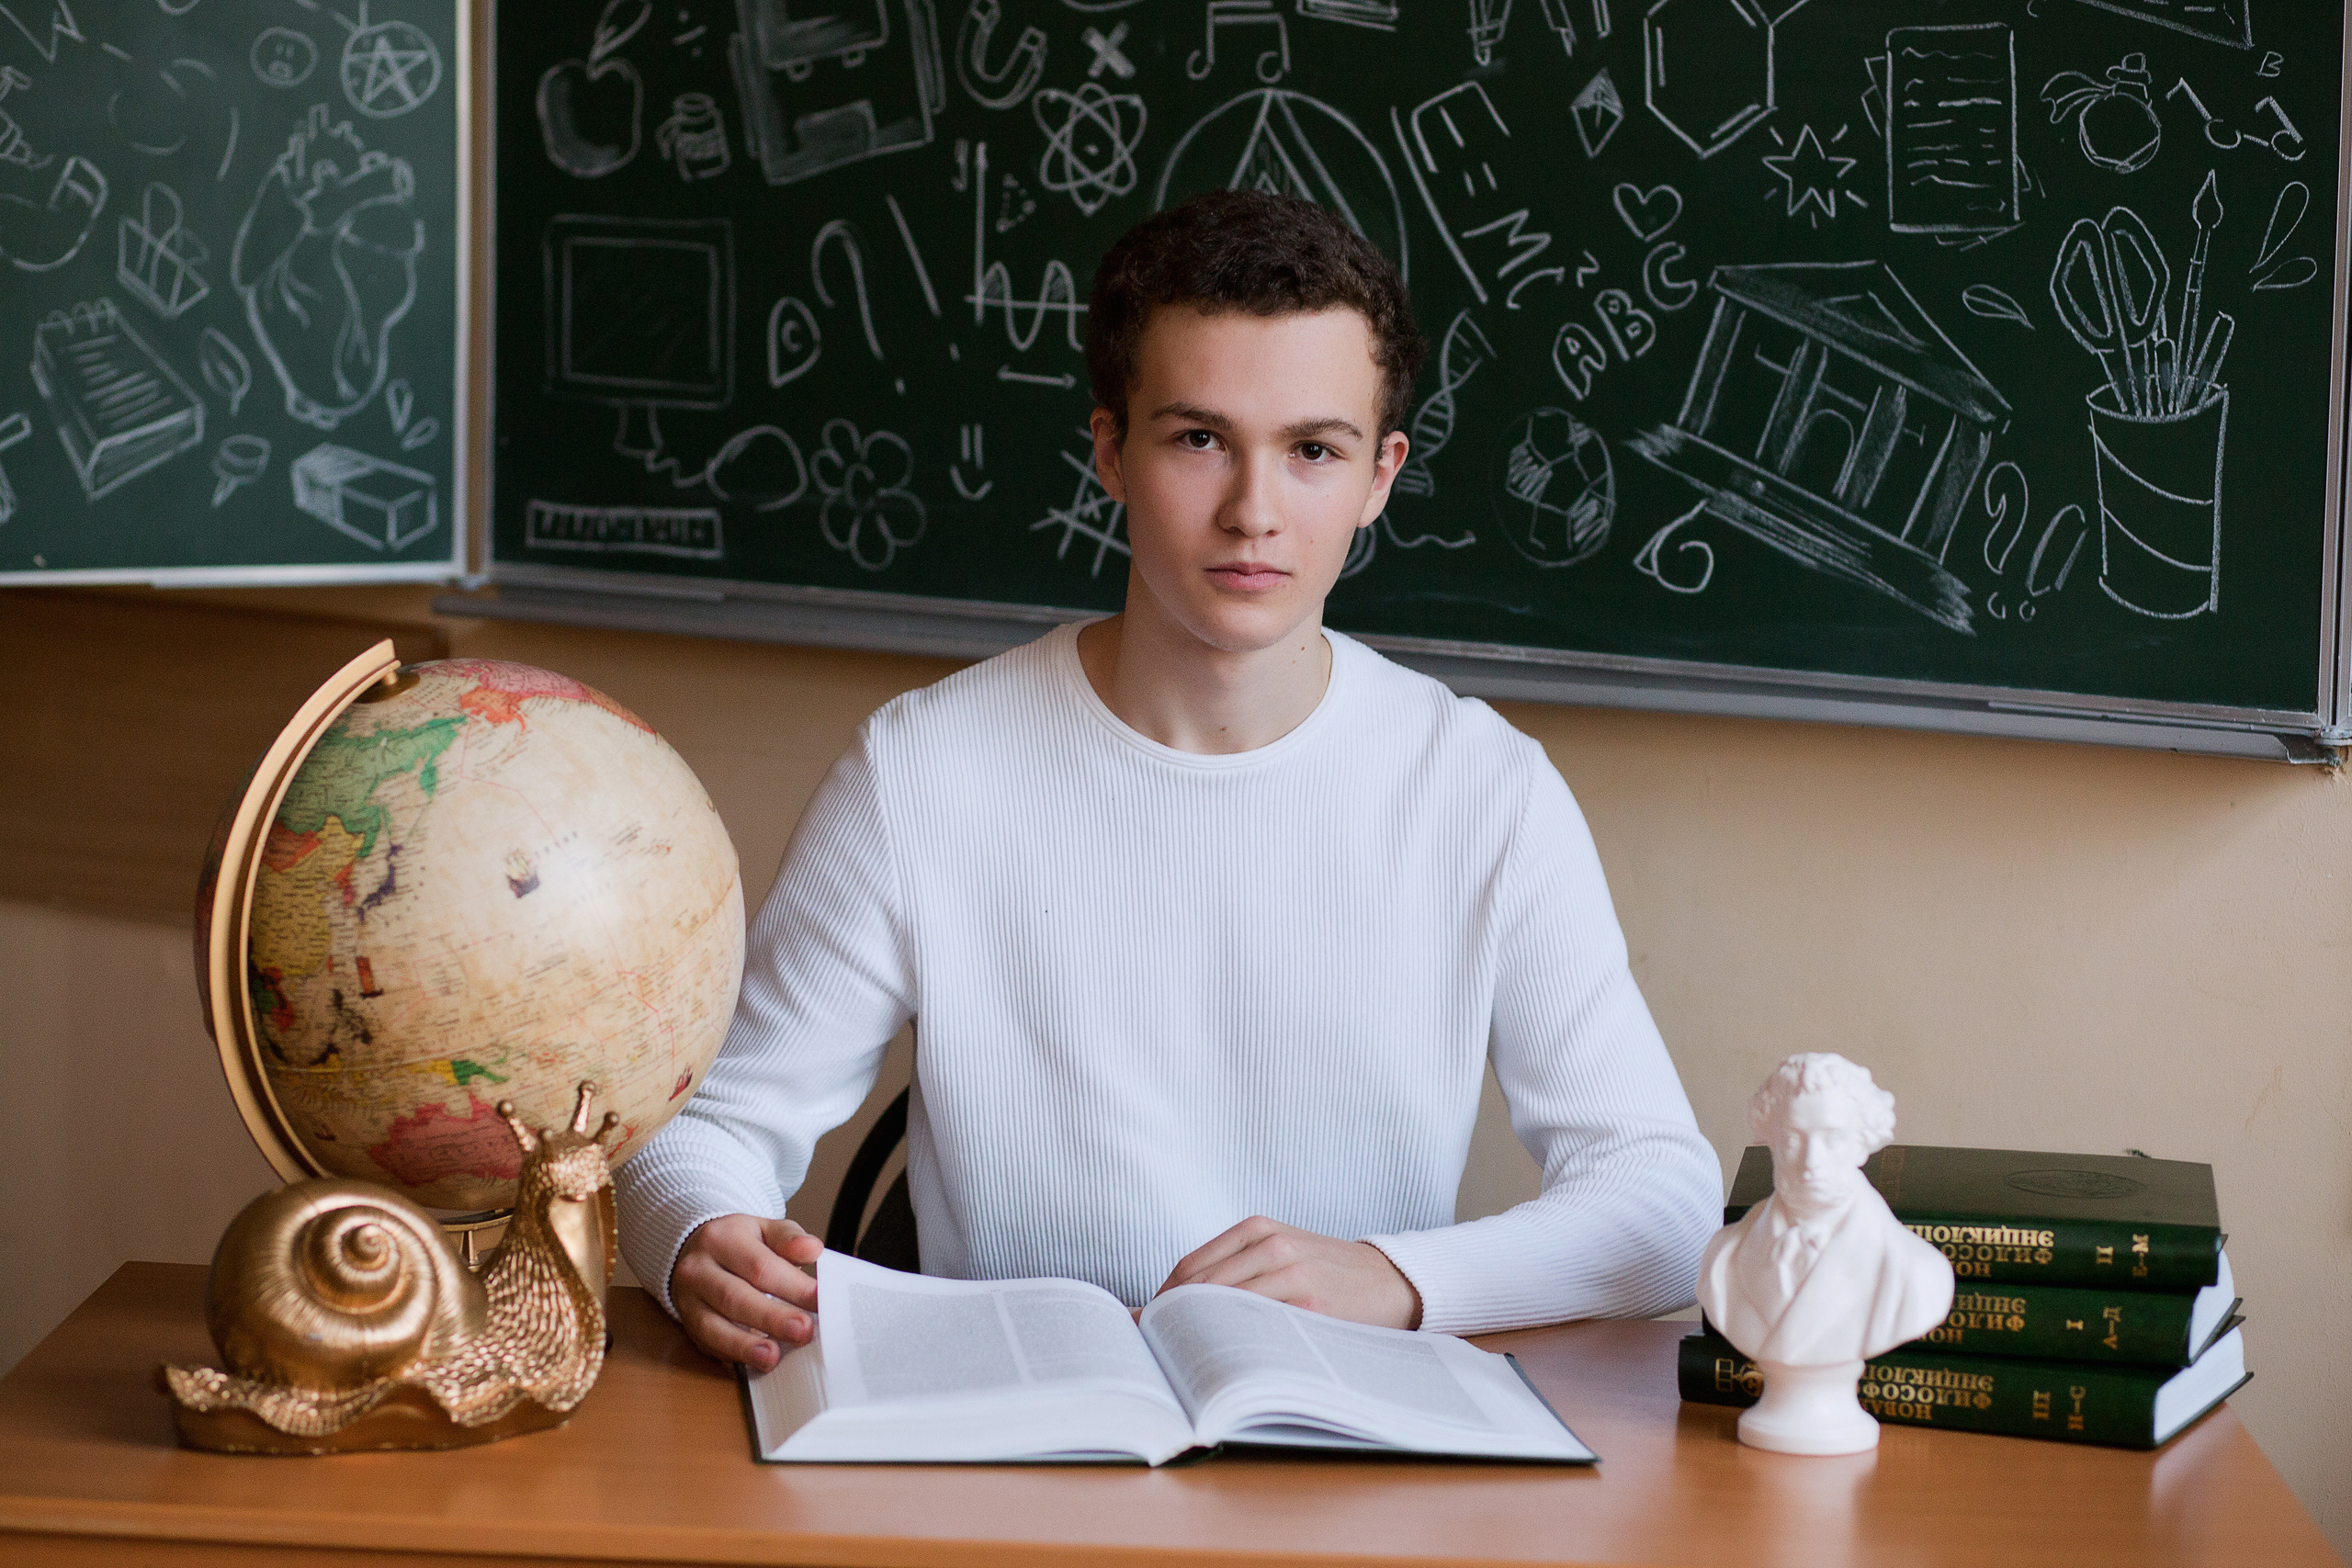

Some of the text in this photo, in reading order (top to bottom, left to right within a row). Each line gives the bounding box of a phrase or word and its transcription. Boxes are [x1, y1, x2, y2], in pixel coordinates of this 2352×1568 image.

[2256, 51, 2285, 77] B
[1552, 241, 1698, 400] ABC
[1940, 1243, 2054, 1266] ФИЛОСО
[1949, 1259, 1992, 1278] НО
[1952, 1292, 2027, 1314] ЭНЦИ
[1946, 1312, 2026, 1333] ФИЛО
[1857, 1383, 1993, 1410] ФИЛОСОФ
